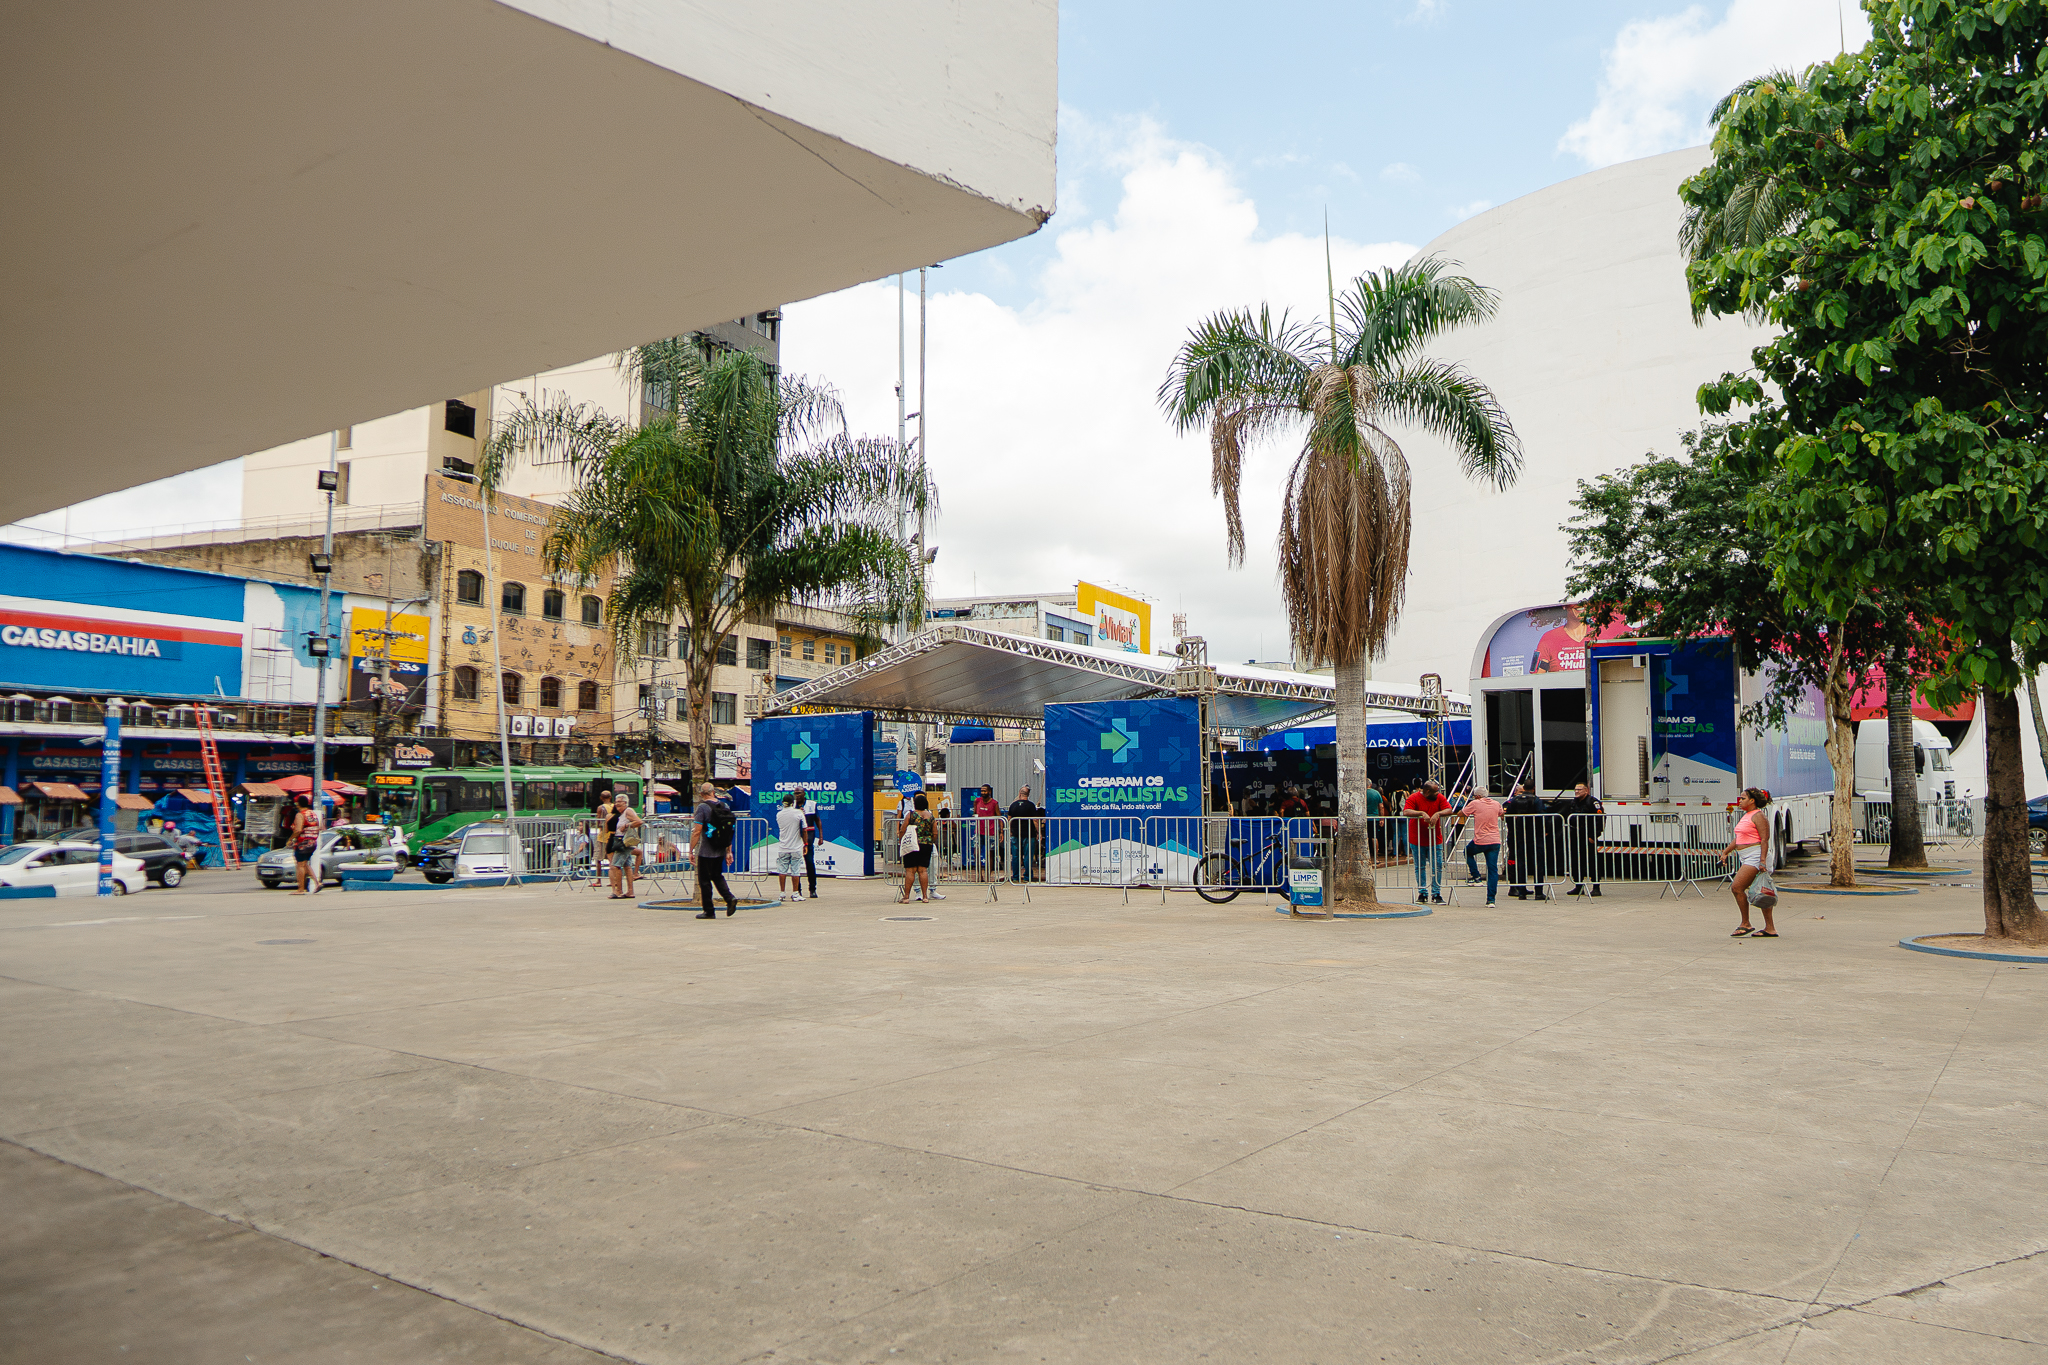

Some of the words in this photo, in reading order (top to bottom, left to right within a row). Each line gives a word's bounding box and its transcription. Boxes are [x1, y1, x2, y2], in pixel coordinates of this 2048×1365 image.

[524, 528, 536, 540] DE
[490, 538, 518, 553] DUQUE
[524, 545, 535, 557] DE
[1104, 614, 1132, 645] Vivian
[1557, 649, 1585, 661] Caxia
[33, 756, 102, 769] CASASBA
[153, 759, 227, 771] CASASBA
[256, 761, 313, 772] CASASBAH
[823, 781, 837, 790] OS
[1078, 776, 1144, 788] CHEGARAM
[1145, 775, 1164, 787] OS
[1252, 780, 1263, 789] 03
[1283, 780, 1293, 788] 04
[1314, 780, 1324, 789] 05
[1377, 778, 1388, 787] 07
[758, 790, 854, 804] ESPALISTAS
[1056, 786, 1188, 803] ESPECIALISTAS
[1080, 803, 1102, 811] Saindo
[1102, 803, 1110, 811] da
[1146, 802, 1162, 810] você!
[1293, 874, 1318, 882] LIMPO
